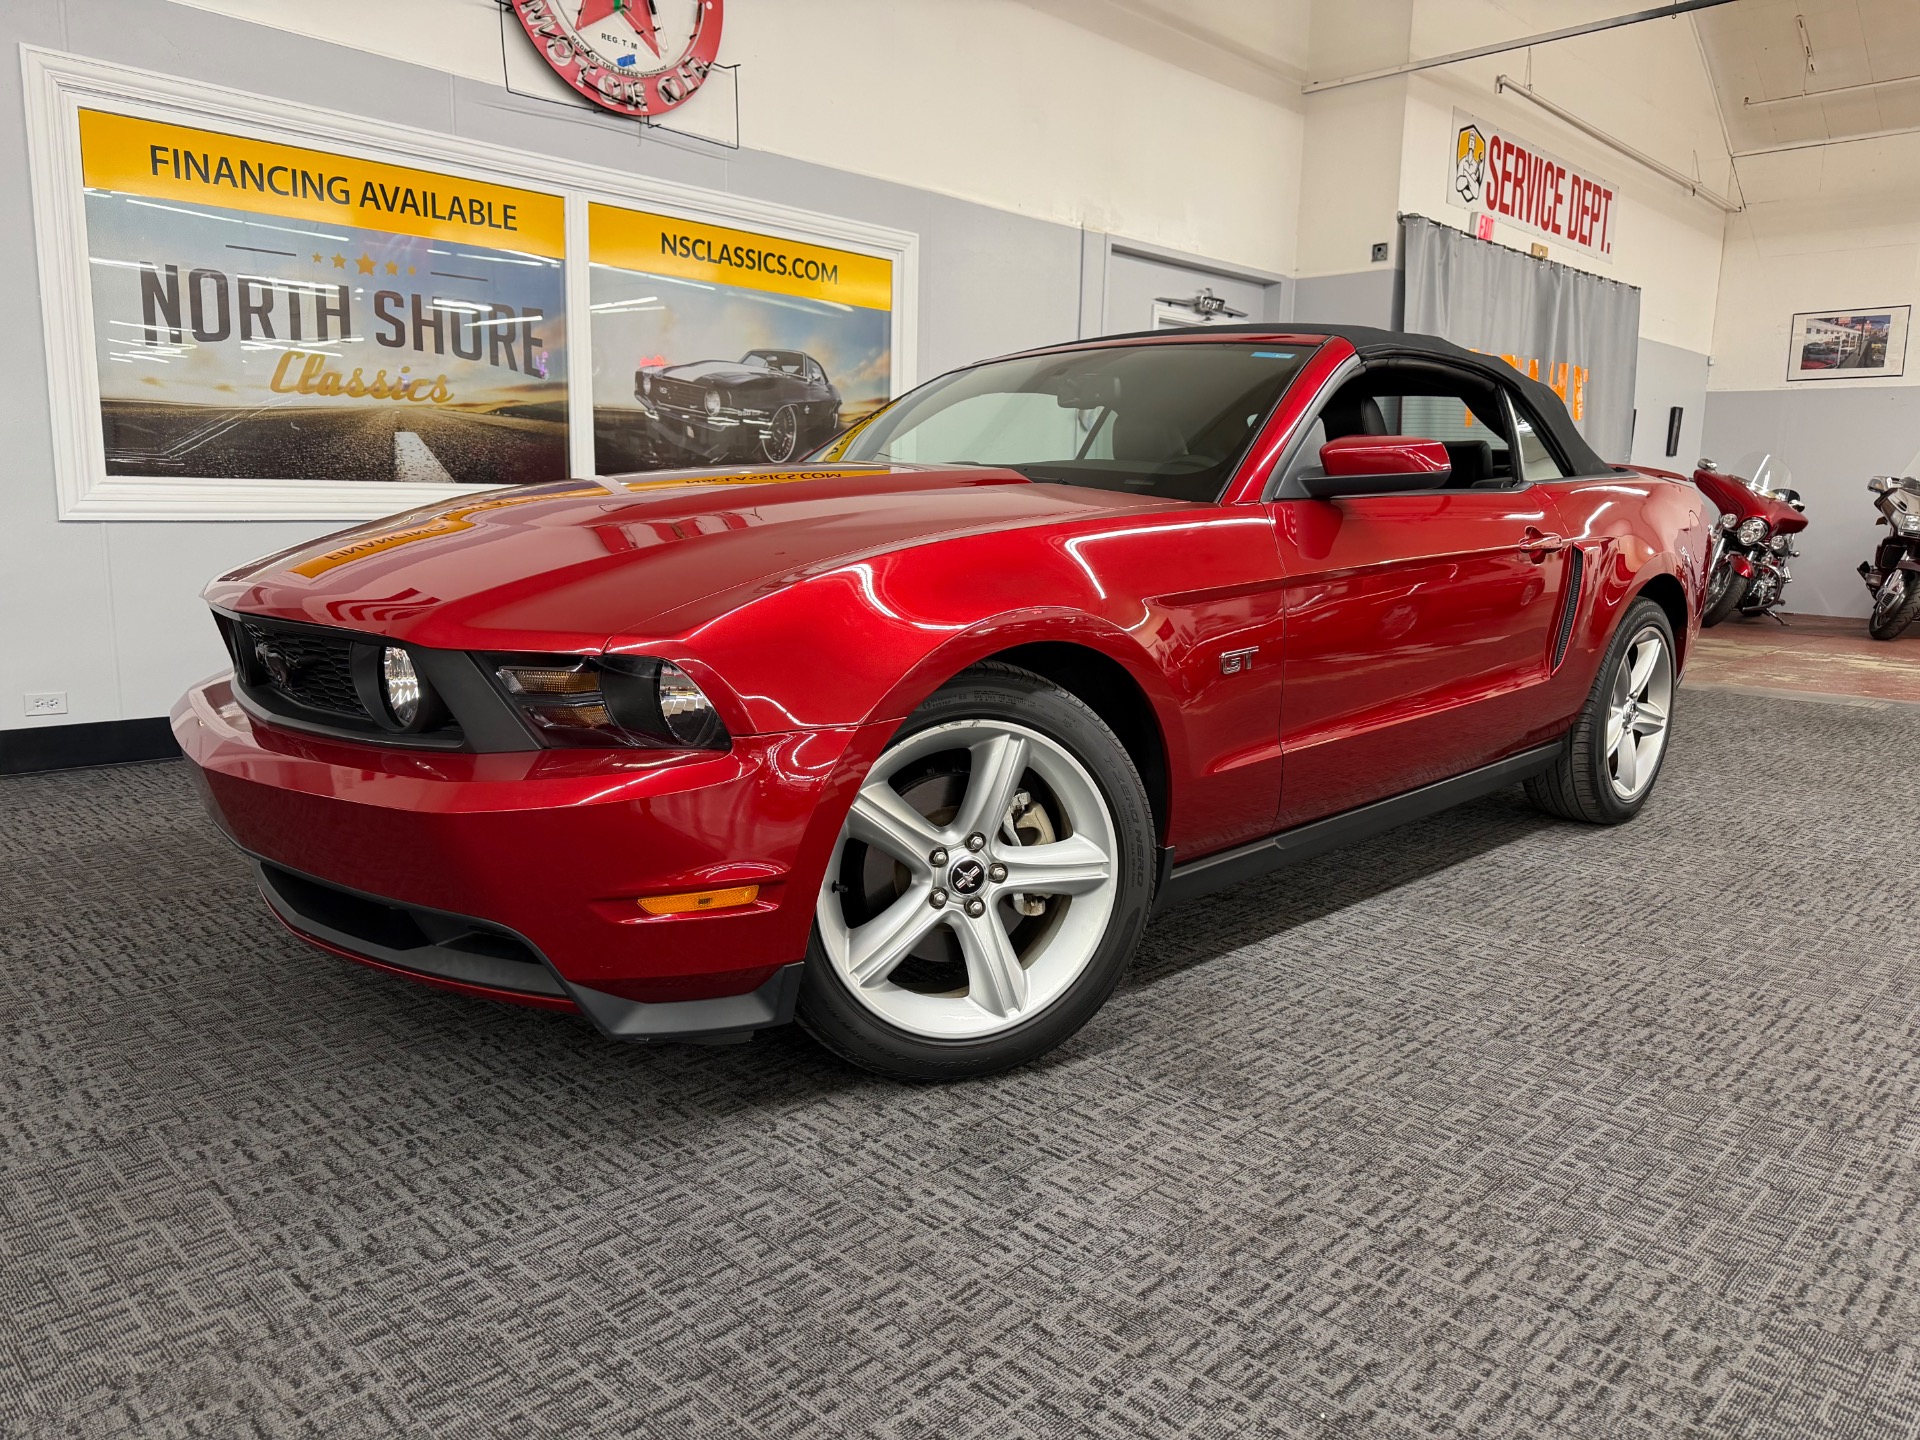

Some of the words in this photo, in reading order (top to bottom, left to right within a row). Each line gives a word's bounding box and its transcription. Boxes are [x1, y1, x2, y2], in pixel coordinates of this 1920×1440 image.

[519, 0, 649, 112] MOTOR
[602, 61, 615, 72] THE
[149, 143, 351, 205] FINANCING
[359, 181, 518, 231] AVAILABLE
[1485, 135, 1566, 235] SERVICE
[1567, 173, 1613, 254] DEPT.
[661, 231, 839, 285] NSCLASSICS.COM
[139, 260, 351, 346] NORTH
[374, 290, 544, 379] SHORE
[270, 350, 454, 403] Classics
[1219, 646, 1259, 674] GT
